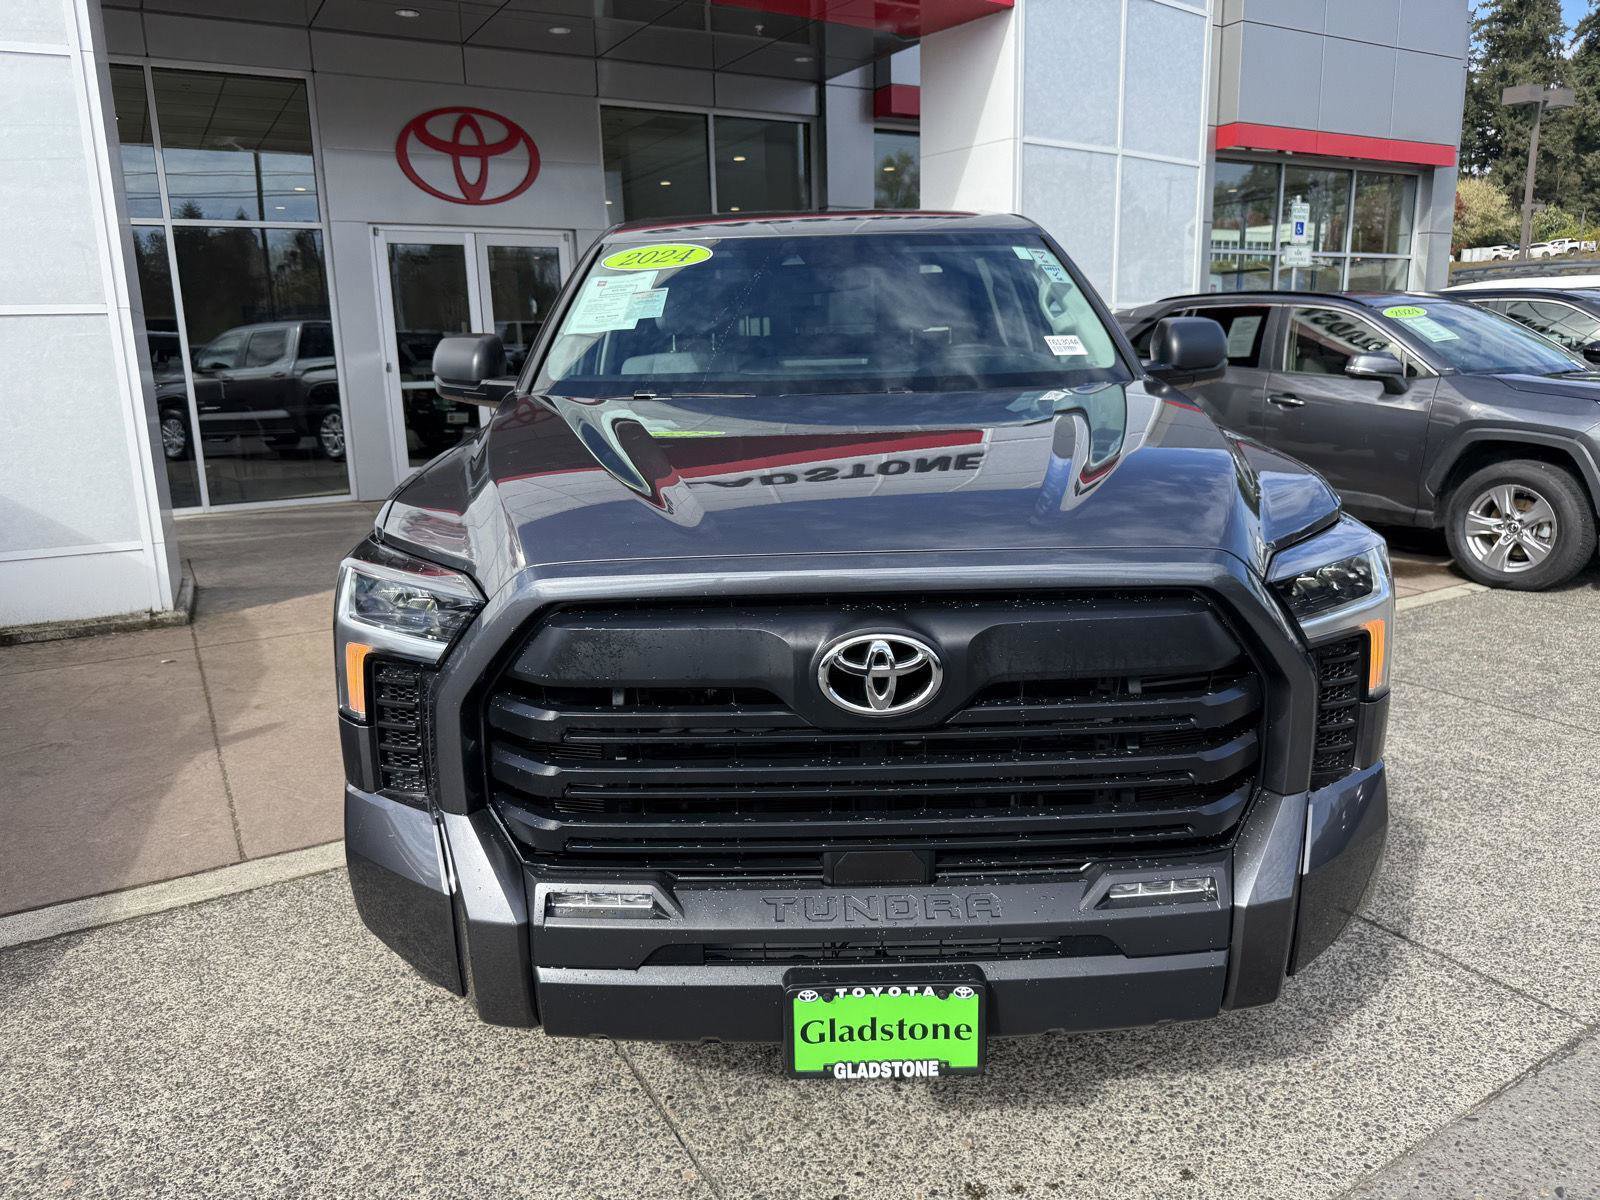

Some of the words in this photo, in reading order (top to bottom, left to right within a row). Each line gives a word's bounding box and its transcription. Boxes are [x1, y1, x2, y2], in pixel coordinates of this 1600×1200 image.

[617, 248, 696, 266] 2024
[762, 892, 1002, 922] TUNDRA
[836, 986, 935, 998] TOYOTA
[800, 1017, 973, 1044] Gladstone
[833, 1060, 939, 1079] GLADSTONE
